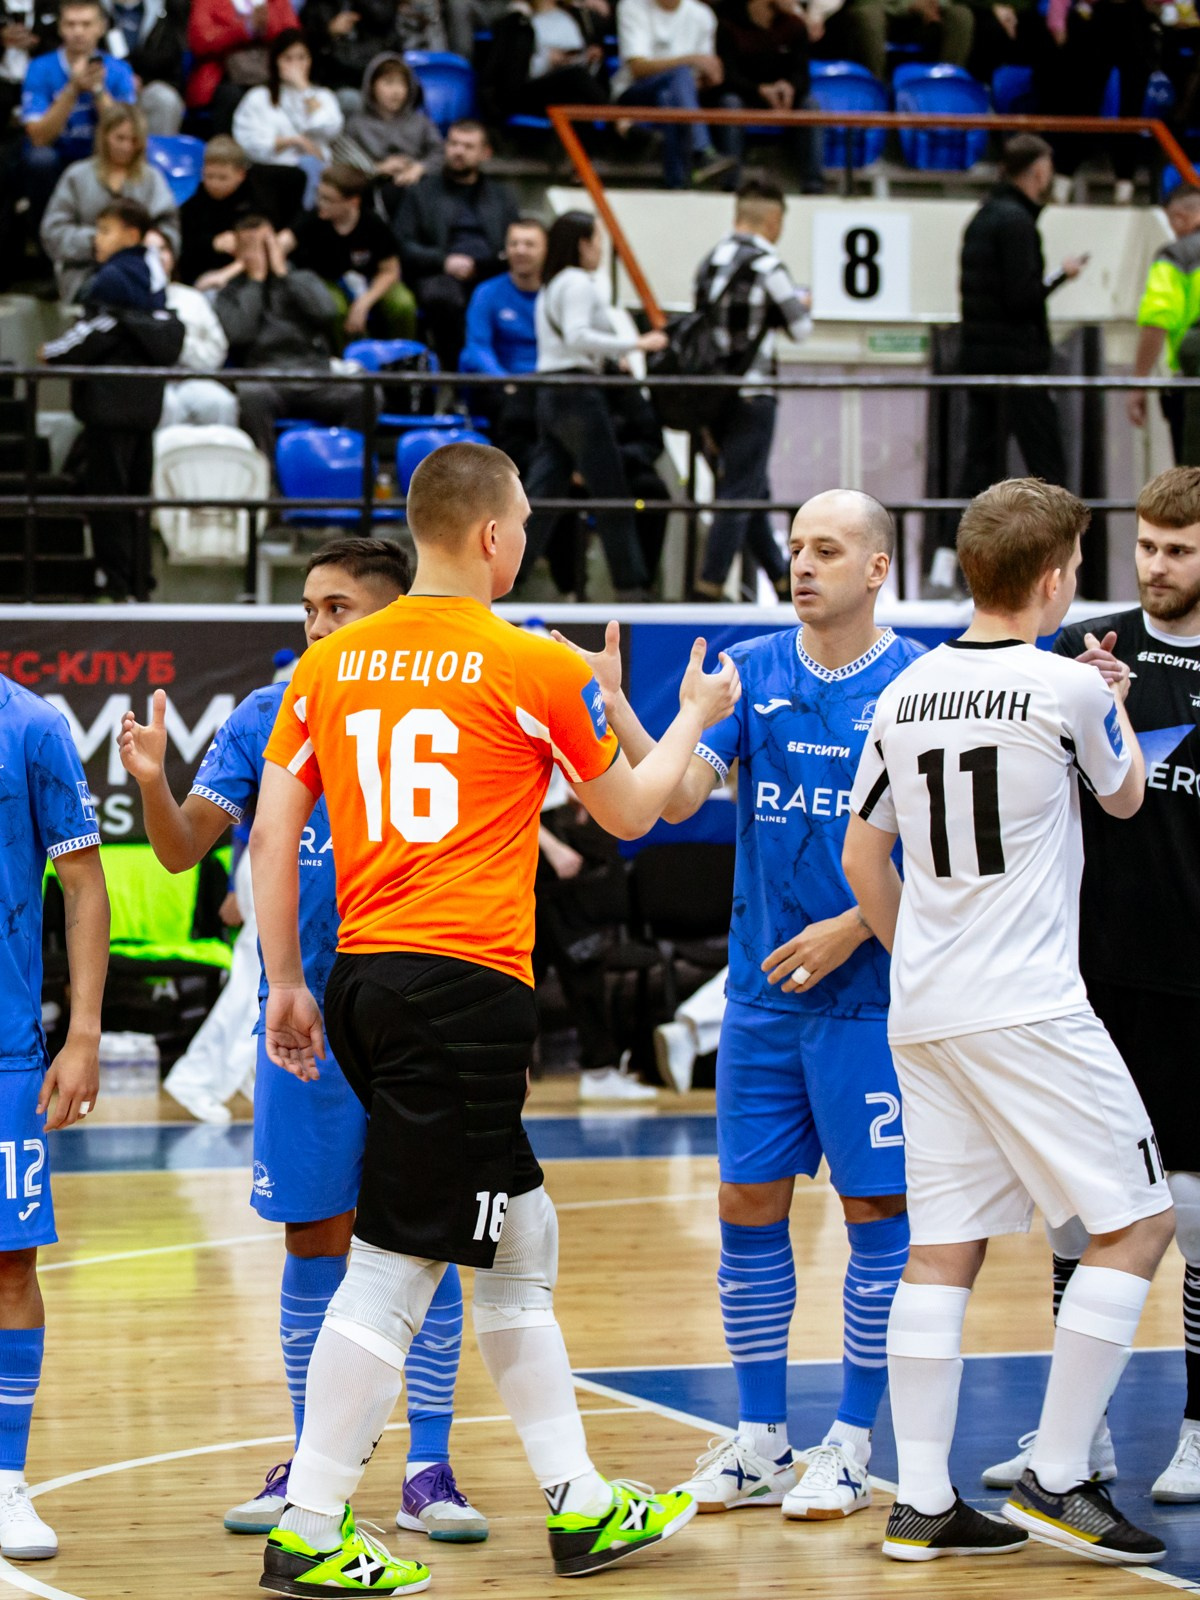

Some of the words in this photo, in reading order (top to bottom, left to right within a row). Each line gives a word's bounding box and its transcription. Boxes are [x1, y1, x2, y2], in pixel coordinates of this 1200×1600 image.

[844, 227, 881, 299] 8
[337, 650, 484, 687] ШВЕЦОВ
[896, 690, 1031, 724] ШИШКИН
[345, 708, 460, 843] 16
[787, 741, 850, 758] БЕТСИТИ
[917, 746, 1005, 877] 11
[865, 1091, 905, 1149] 2
[0, 1139, 45, 1199] 12
[472, 1191, 509, 1242] 16
